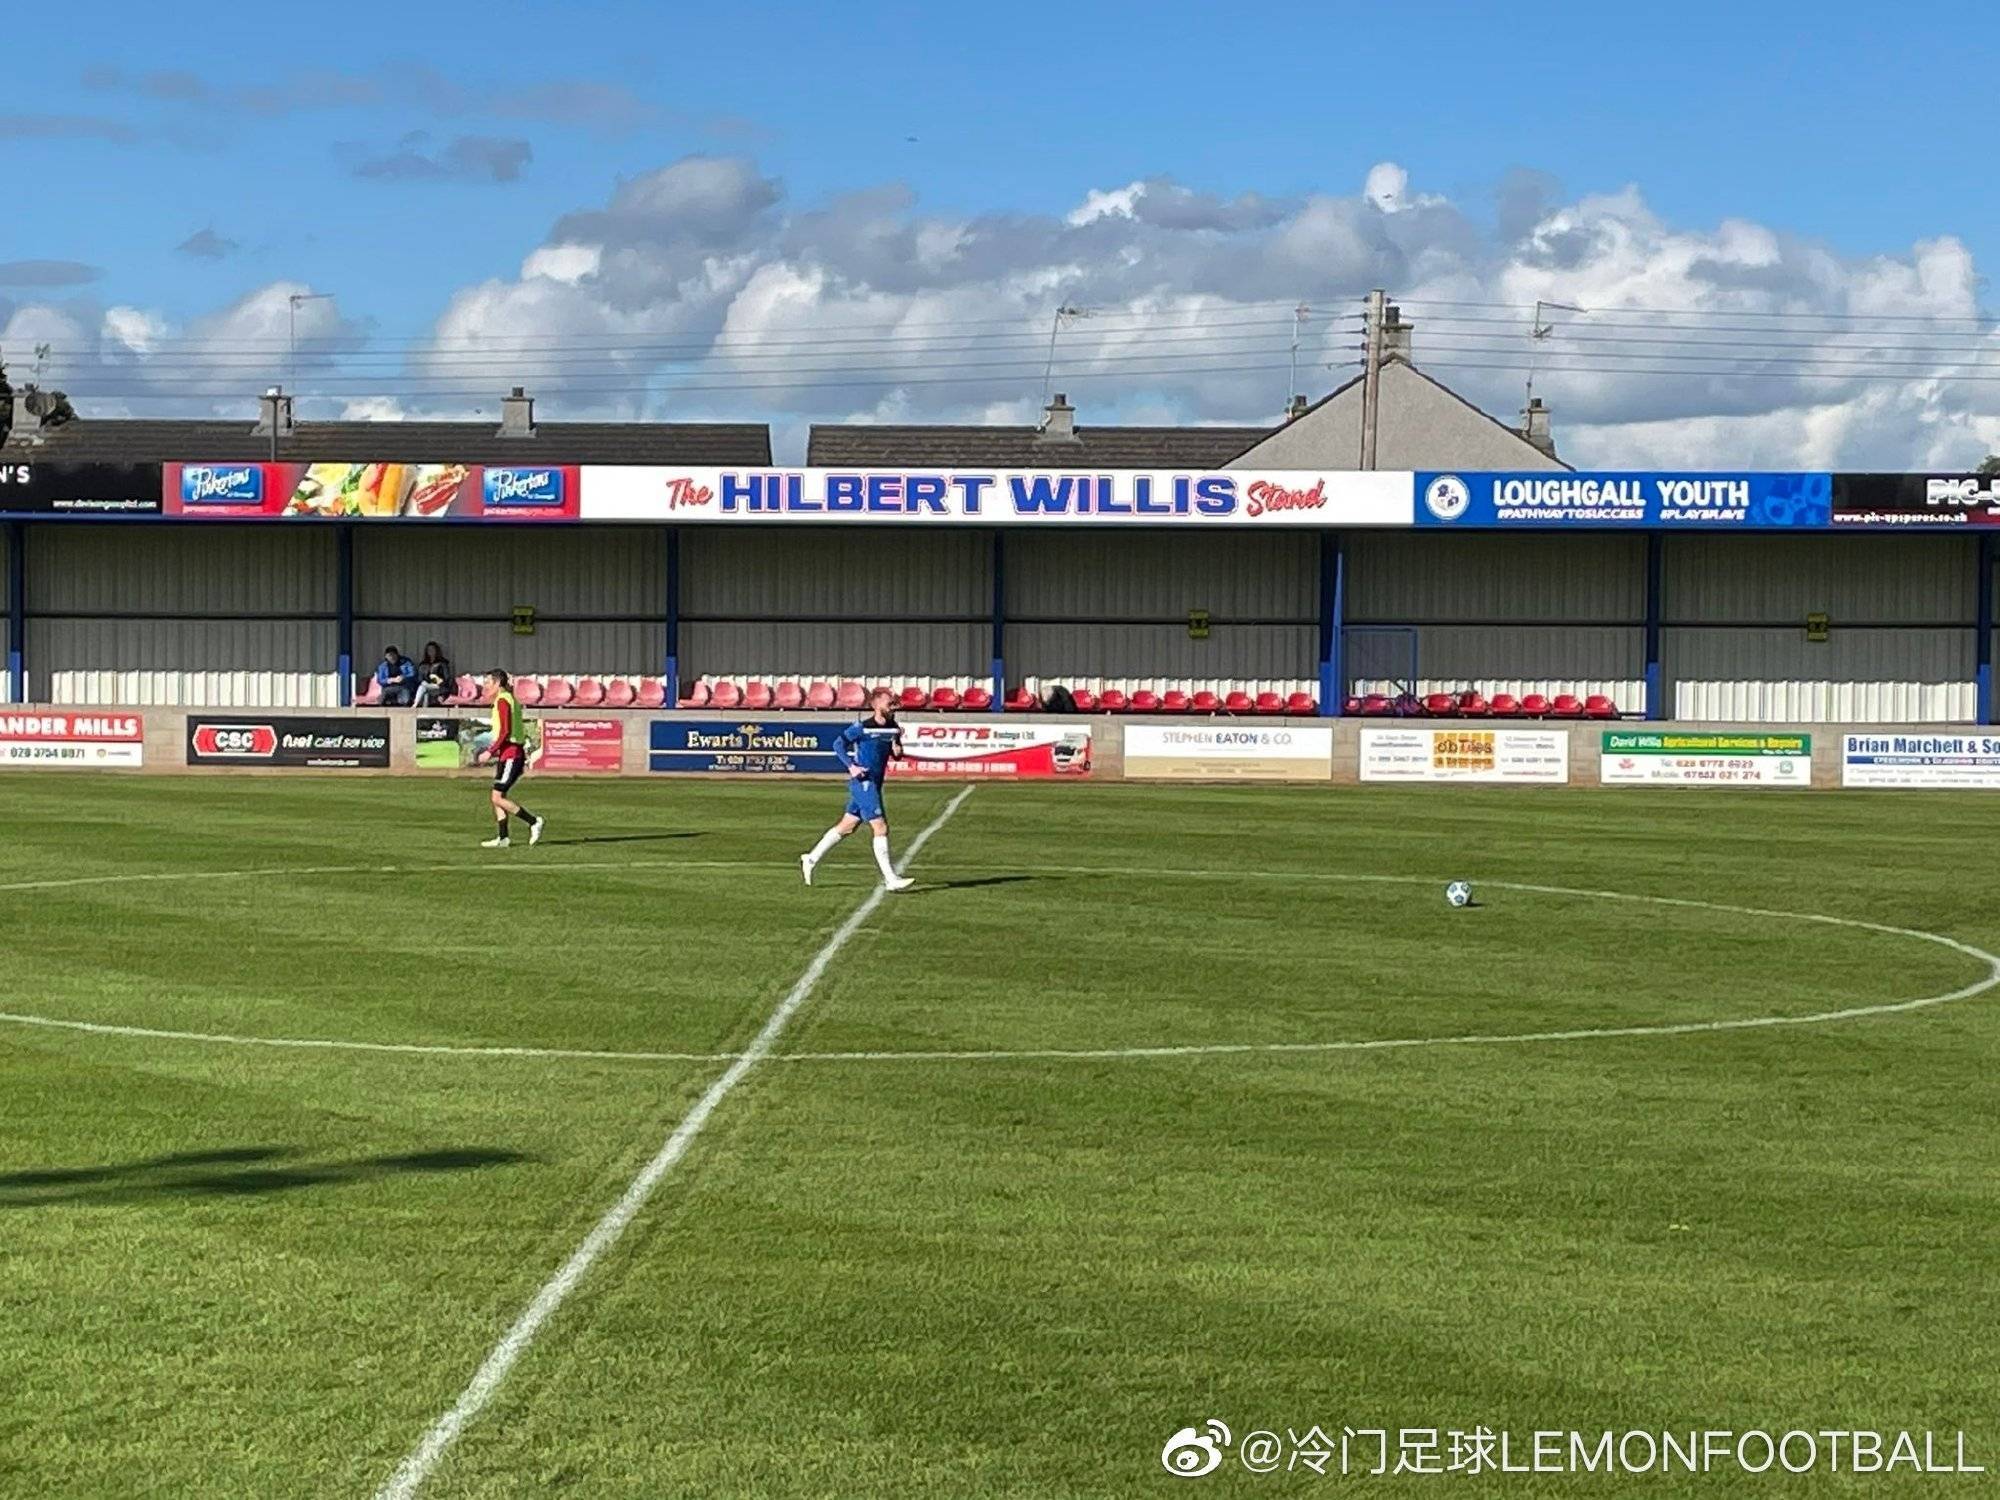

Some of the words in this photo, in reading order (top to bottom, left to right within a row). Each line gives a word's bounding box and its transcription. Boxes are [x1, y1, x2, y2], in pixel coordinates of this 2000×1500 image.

[666, 477, 714, 510] The
[720, 473, 997, 514] HILBERT
[1006, 474, 1239, 516] WILLIS
[1246, 478, 1328, 517] Stand
[1493, 480, 1646, 506] LOUGHGALL
[1656, 480, 1749, 507] YOUTH
[73, 718, 137, 736] MILLS
[917, 727, 990, 740] POTTS
[282, 734, 313, 748] fuel
[343, 736, 385, 749] service
[687, 730, 743, 748] Ewarts
[747, 731, 818, 750] Jewellers
[1163, 733, 1213, 744] STEPHEN
[1216, 732, 1258, 745] EATON
[1260, 733, 1270, 745] &
[1610, 736, 1636, 748] David
[1848, 737, 1889, 753] Brian
[1894, 737, 1964, 754] Matchett
[1967, 740, 1978, 753] &
